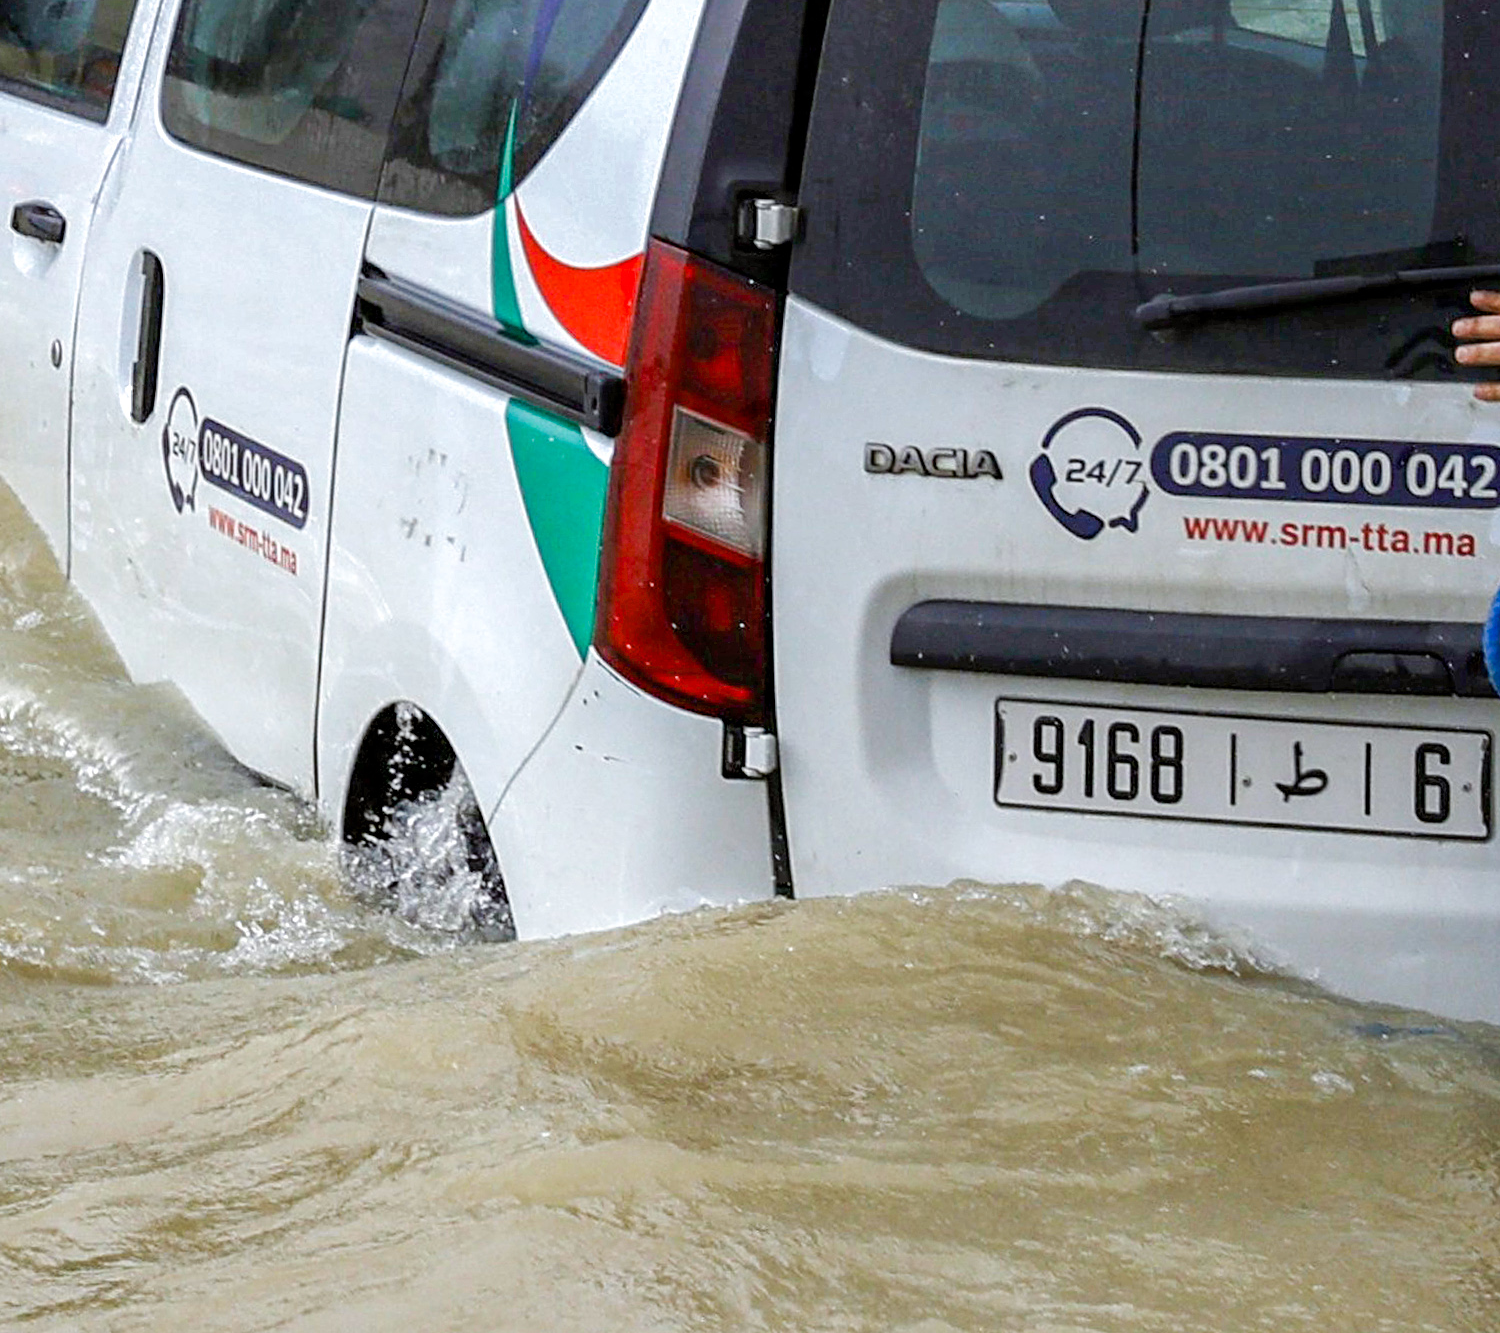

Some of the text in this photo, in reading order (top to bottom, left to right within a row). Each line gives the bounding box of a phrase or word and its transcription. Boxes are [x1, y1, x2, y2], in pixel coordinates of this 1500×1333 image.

[173, 432, 196, 465] 24/7
[203, 428, 305, 519] 0801 000 042
[864, 442, 1003, 480] DACIA
[1065, 459, 1143, 487] 24/7
[1169, 442, 1498, 499] 0801 000 042
[208, 504, 299, 576] www.srm-tta.ma
[1183, 512, 1476, 558] www.srm-tta.ma
[1032, 716, 1184, 803] 9168
[1415, 743, 1450, 824] 6
